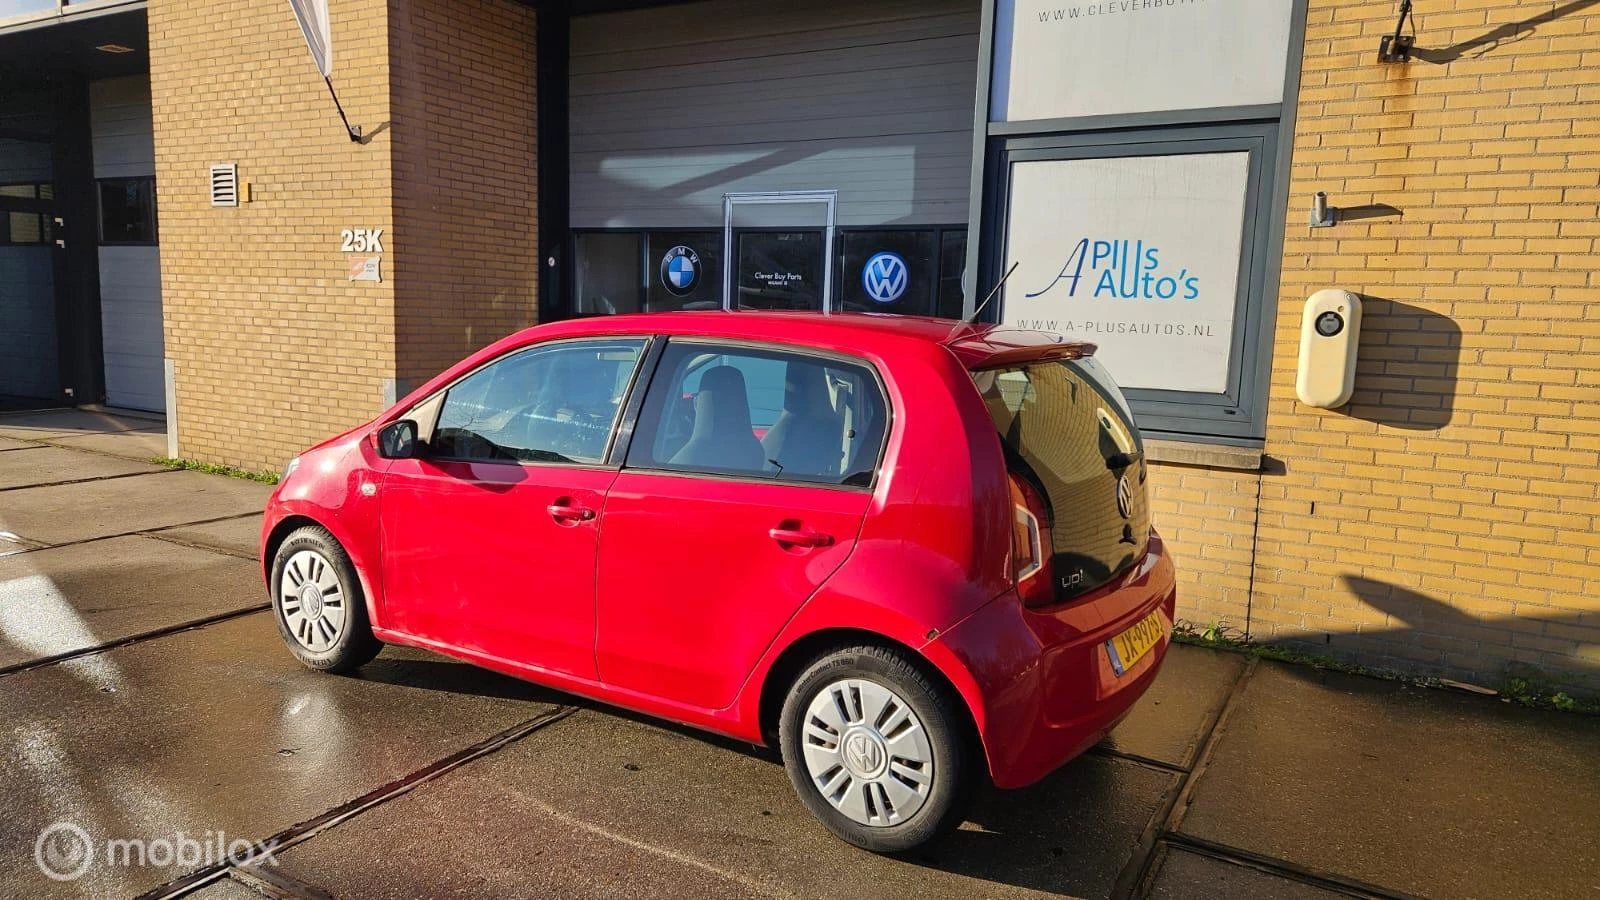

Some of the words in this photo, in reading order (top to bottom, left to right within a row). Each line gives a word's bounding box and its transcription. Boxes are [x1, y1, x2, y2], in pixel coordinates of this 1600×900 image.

[340, 228, 384, 252] 25K
[665, 247, 698, 263] BMW
[754, 271, 773, 280] Clever
[774, 272, 786, 281] Buy
[1016, 319, 1214, 337] WWW.A-PLUSAUTOS.NL
[1061, 568, 1084, 590] up!
